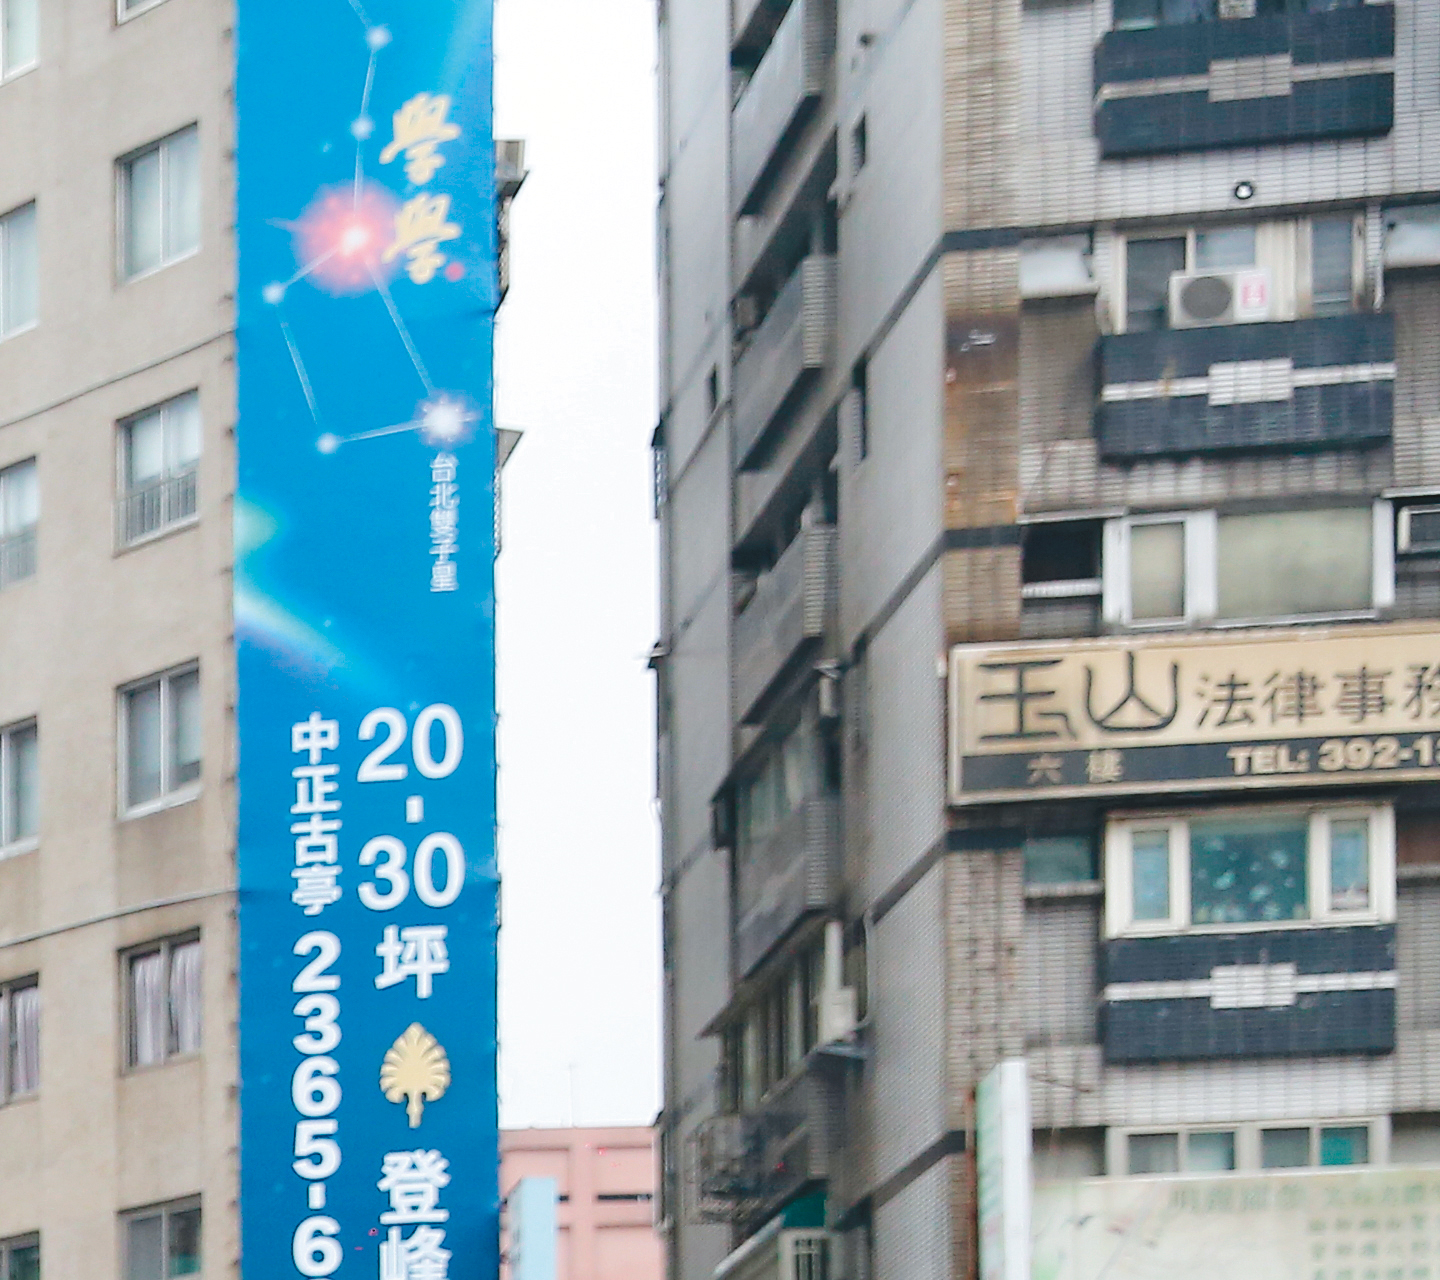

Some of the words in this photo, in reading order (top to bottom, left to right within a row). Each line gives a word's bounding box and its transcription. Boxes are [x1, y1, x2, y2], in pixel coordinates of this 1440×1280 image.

[1027, 750, 1123, 784] 六樓
[1226, 744, 1311, 775] TEL:
[289, 712, 343, 917] 中正古亭
